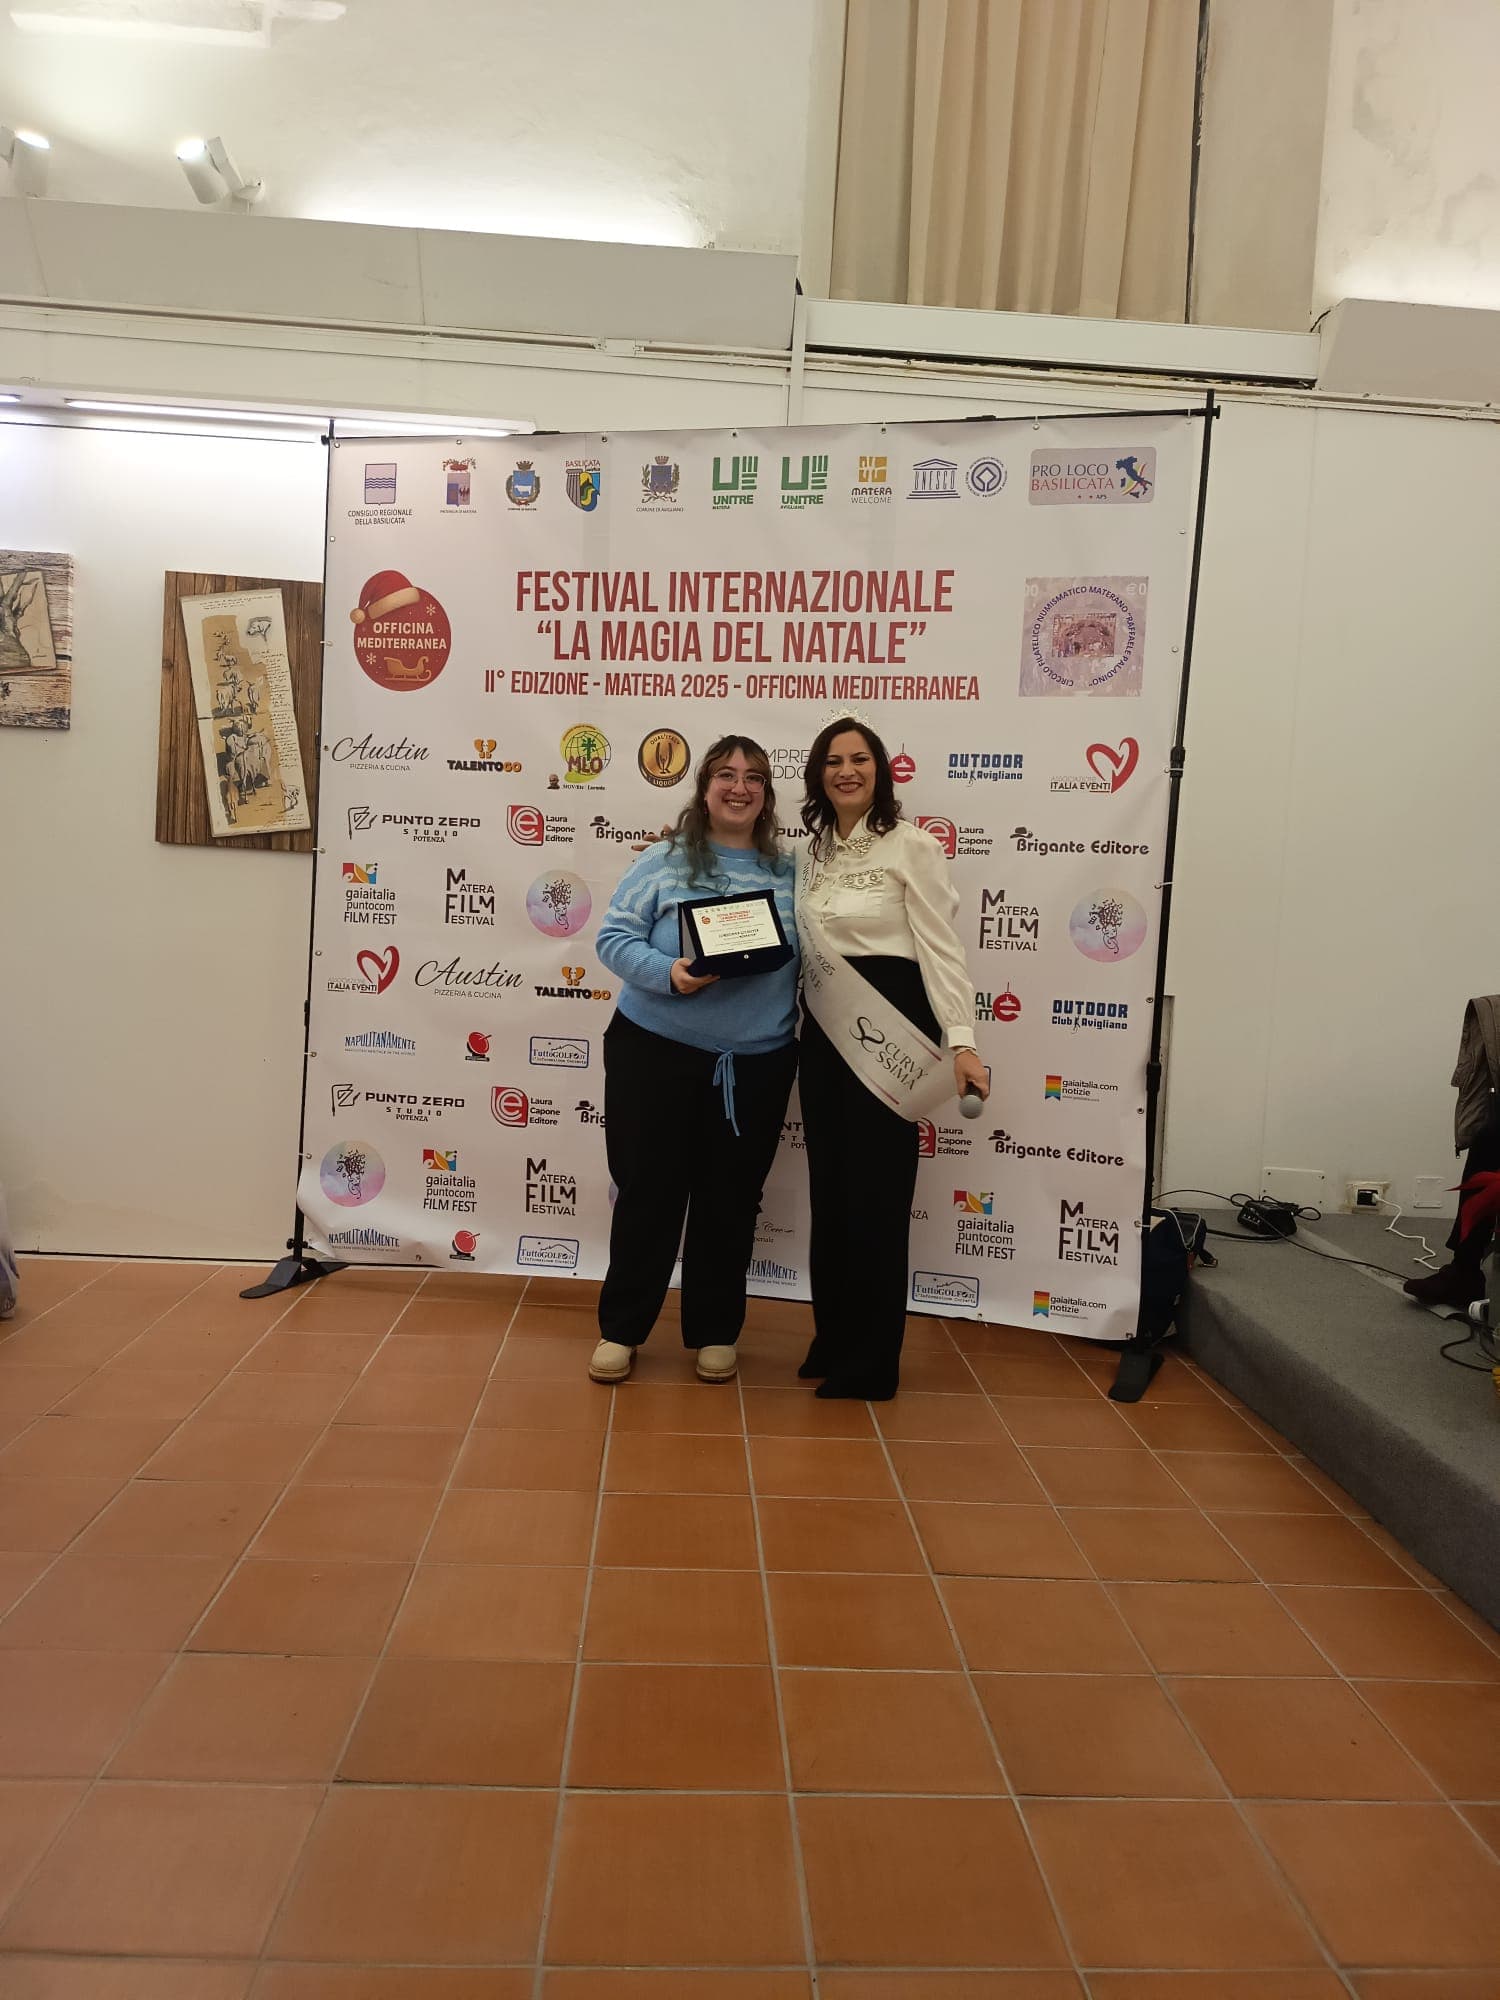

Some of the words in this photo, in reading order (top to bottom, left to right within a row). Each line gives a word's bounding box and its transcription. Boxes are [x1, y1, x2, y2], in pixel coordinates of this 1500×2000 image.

[1032, 464, 1061, 477] PRO
[1067, 464, 1109, 476] LOCO
[914, 470, 956, 490] UNESCO
[1031, 478, 1114, 491] BASILICATA
[851, 487, 892, 496] MATERA
[713, 494, 754, 504] UNITRE
[781, 494, 824, 504] UNITRE
[851, 496, 892, 504] WELCOME
[380, 508, 412, 517] REGIONALE
[373, 517, 405, 525] BASILICATA
[516, 570, 659, 613] FESTIVAL
[668, 570, 955, 613] INTERNAZIONALE
[1038, 586, 1087, 622] NUMISMATICO
[1088, 586, 1128, 613] MATERANO
[373, 622, 434, 634] OFFICINA
[357, 637, 447, 649] MEDITERRANEA
[600, 621, 702, 662] MAGIA
[712, 621, 772, 663] DEL
[1031, 623, 1046, 667] FILATELICO
[1043, 666, 1074, 687] CIRCOLO
[511, 670, 589, 696] EDIZIONE
[605, 672, 676, 697] MATERA
[681, 674, 729, 698] 2025
[746, 674, 827, 700] OFFICINA
[832, 675, 980, 701] MEDITERRANEA
[331, 733, 430, 762] Austin
[763, 748, 812, 763] MPRE
[949, 753, 1023, 769] OUTDOOR
[948, 770, 968, 779] Club
[977, 771, 1023, 781] Avigliano
[1050, 782, 1077, 790] ITALIA
[1080, 782, 1111, 790] EVENTI
[382, 814, 434, 826] PUNTO
[438, 817, 481, 828] ZERO
[546, 815, 567, 823] Laura
[403, 828, 458, 837] STUDIO
[545, 825, 575, 834] Capone
[776, 828, 810, 838] PUN
[959, 826, 984, 834] Laura
[413, 835, 445, 843] POTENZA
[545, 835, 574, 843] Editore
[958, 837, 993, 846] Capone
[958, 847, 990, 856] Editore
[1016, 838, 1085, 856] Brigante
[1091, 840, 1150, 855] Editore
[345, 887, 396, 901] gaiaitalia
[346, 901, 395, 912] puntocom
[344, 912, 369, 924] FILM
[372, 913, 397, 925] FEST
[414, 956, 523, 988] Austin
[328, 982, 350, 990] ITALIA
[352, 984, 377, 992] EVENTI
[434, 988, 466, 997] PIZZERIA
[474, 991, 502, 999] CUCINA
[1053, 999, 1128, 1018] OUTDOOR
[1052, 1016, 1072, 1026] Club
[1082, 1018, 1128, 1030] Avigliano
[885, 1042, 928, 1080] CURVY
[876, 1050, 915, 1091] SSIMA
[1062, 1080, 1119, 1091] gaiaitalia.com
[1062, 1087, 1091, 1096] notizie
[365, 1092, 417, 1105] PUNTO
[422, 1095, 465, 1108] ZERO
[530, 1097, 552, 1105] Laura
[386, 1106, 442, 1117] STUDIO
[530, 1107, 560, 1116] Capone
[396, 1114, 428, 1122] POTENZA
[529, 1117, 558, 1125] Editore
[581, 1111, 606, 1128] Brig
[938, 1126, 963, 1135] Laura
[937, 1137, 972, 1146] Capone
[937, 1147, 969, 1156] Editore
[995, 1140, 1061, 1159] Brigante
[1067, 1148, 1125, 1166] Editore
[425, 1174, 476, 1188] gaiaitalia
[426, 1187, 475, 1199] puntocom
[423, 1199, 449, 1211] FILM
[452, 1200, 477, 1213] FEST
[957, 1217, 1014, 1234] gaiaitalia
[958, 1231, 1013, 1246] puntocom
[955, 1243, 984, 1257] FILM
[987, 1246, 1016, 1261] FEST
[1050, 1296, 1107, 1309] gaiaitalia.com
[1050, 1304, 1079, 1314] notizie
